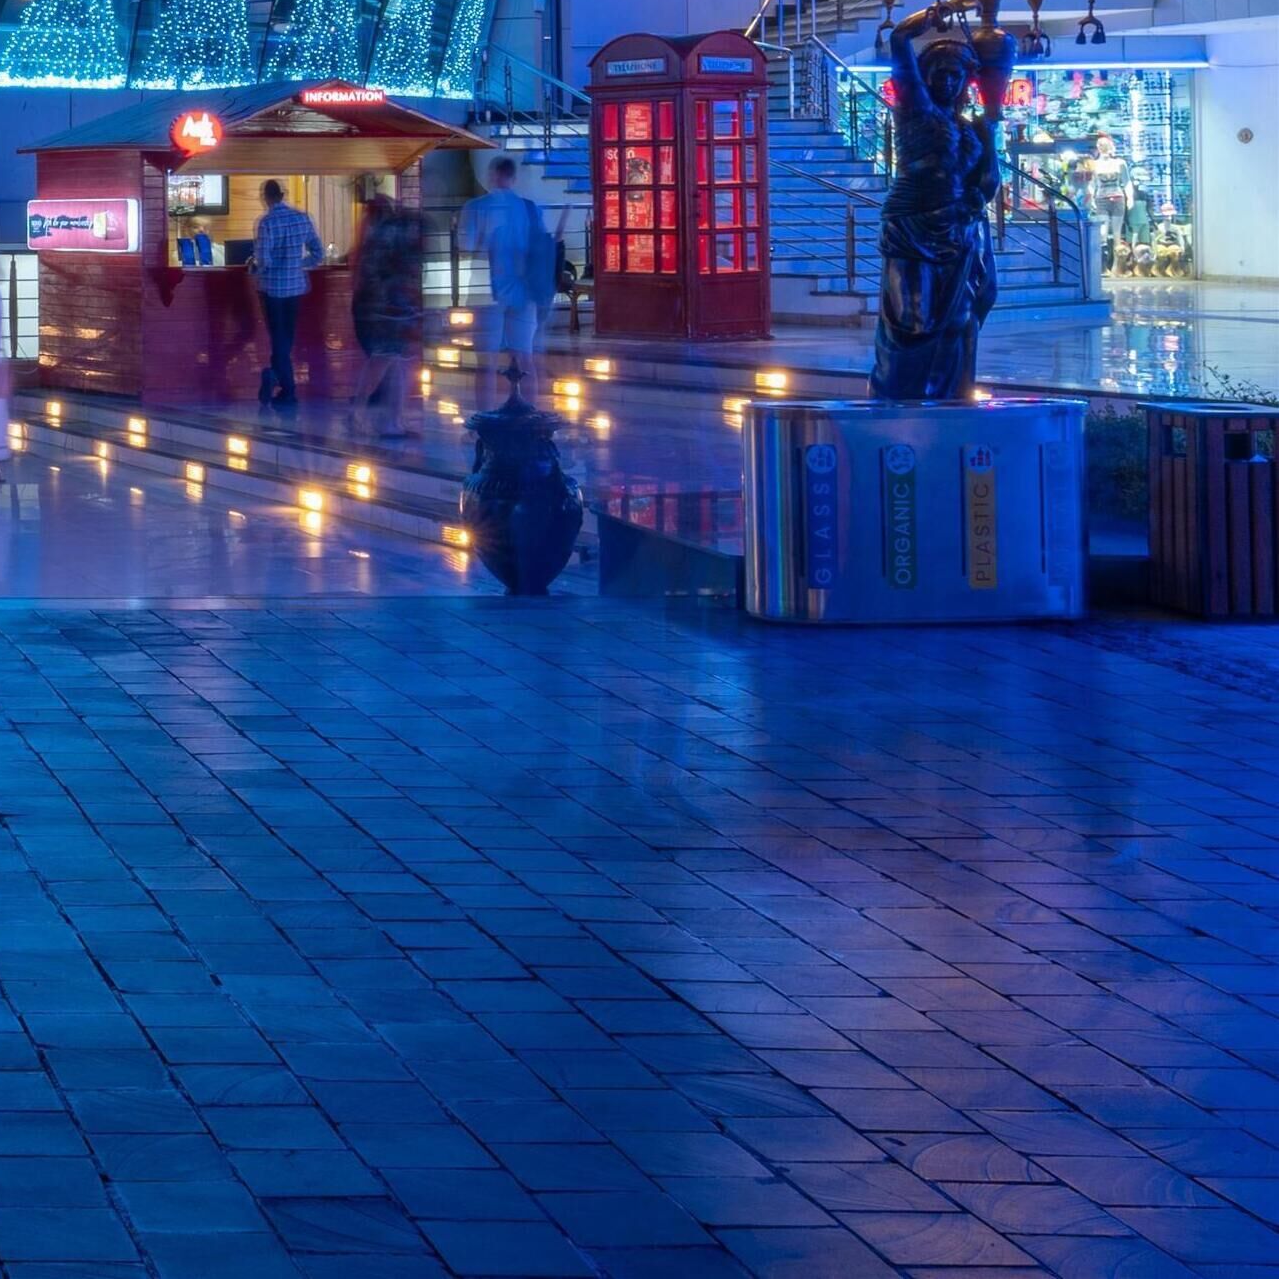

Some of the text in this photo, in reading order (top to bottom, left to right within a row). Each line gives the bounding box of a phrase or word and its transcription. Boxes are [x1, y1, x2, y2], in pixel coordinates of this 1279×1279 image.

[305, 91, 383, 102] INFORMATION
[814, 482, 832, 584] GLASS
[894, 482, 911, 585] ORGANIC
[972, 482, 991, 582] PLASTIC
